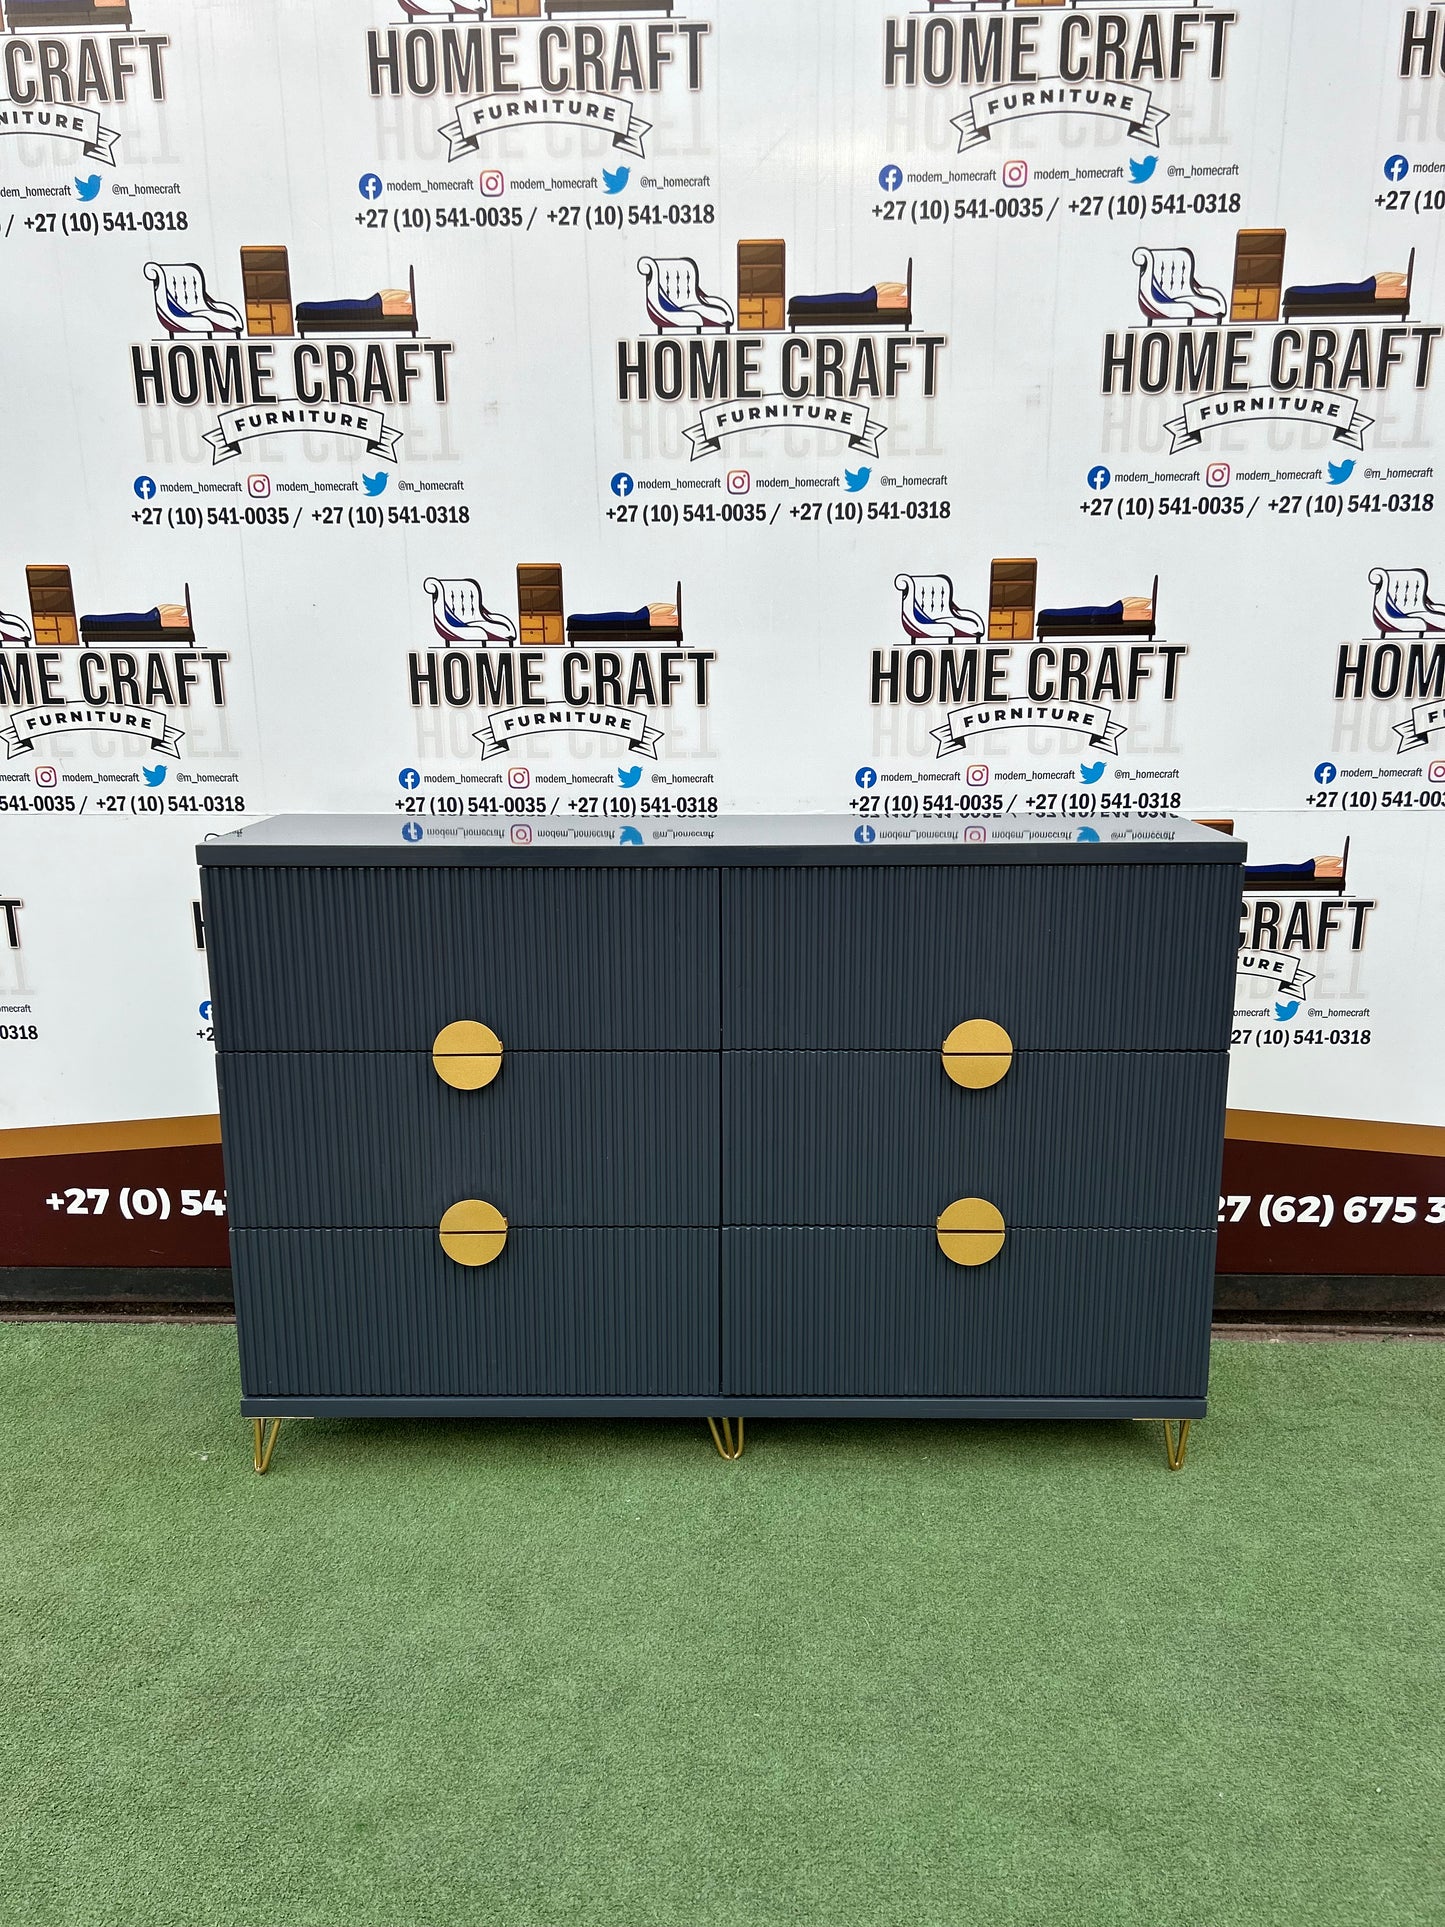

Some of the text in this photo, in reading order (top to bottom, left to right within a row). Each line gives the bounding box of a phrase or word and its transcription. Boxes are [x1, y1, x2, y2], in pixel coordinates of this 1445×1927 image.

[368, 24, 709, 96] HOME CRAFT
[886, 14, 1237, 86] HOME CRAFT
[5, 37, 170, 107] CRAFT
[474, 99, 615, 124] FURNITURE
[987, 90, 1135, 114] FURNITURE
[1168, 164, 1239, 178] @m_homecraft
[112, 183, 180, 196] @m_homecraft
[641, 176, 710, 189] @m_homecraft
[872, 201, 906, 220] +27
[912, 200, 949, 224] (10)
[954, 198, 1043, 219] 541-0035
[1069, 196, 1103, 216] +27
[1108, 195, 1146, 220] (10)
[1152, 193, 1240, 214] 541-0318
[1375, 191, 1410, 210] +27
[24, 214, 56, 232] +27
[62, 213, 98, 236] (10)
[103, 211, 188, 231] 541-0318
[355, 209, 388, 228] +27
[394, 208, 430, 232] (10)
[436, 207, 522, 227] 541-0035
[547, 207, 580, 225] +27
[586, 206, 623, 230] (10)
[629, 204, 714, 225] 541-0318
[618, 337, 946, 402] HOME CRAFT
[1103, 328, 1441, 396] HOME CRAFT
[132, 344, 453, 407] HOME CRAFT
[717, 405, 853, 426] FURNITURE
[1200, 397, 1340, 420] FURNITURE
[235, 410, 368, 431] FURNITURE
[881, 475, 947, 487] @m_homecraft
[1364, 467, 1433, 480] @m_homecraft
[398, 480, 464, 492] @m_homecraft
[606, 505, 638, 522] +27
[643, 505, 678, 526] (10)
[683, 504, 766, 522] 541-0035
[790, 503, 822, 520] +27
[827, 503, 862, 524] (10)
[868, 501, 950, 519] 541-0318
[1080, 498, 1113, 515] +27
[1118, 498, 1154, 519] (10)
[1159, 497, 1244, 515] 541-0035
[1268, 496, 1302, 513] +27
[1306, 494, 1343, 518] (10)
[1348, 494, 1434, 512] 541-0318
[132, 508, 162, 524] +27
[168, 508, 203, 529] (10)
[208, 507, 289, 525] 541-0035
[312, 507, 343, 524] +27
[349, 507, 383, 528] (10)
[388, 506, 469, 524] 541-0318
[80, 653, 229, 706] CRAFT
[409, 652, 715, 708] HOME CRAFT
[872, 646, 1187, 705] HOME CRAFT
[26, 711, 151, 729] FURNITURE
[504, 712, 631, 730] FURNITURE
[964, 708, 1094, 727] FURNITURE
[177, 773, 239, 783] @m_homecraft
[652, 774, 713, 784] @m_homecraft
[1115, 769, 1179, 780] @m_homecraft
[97, 796, 125, 811] +27
[131, 796, 164, 815] (10)
[168, 796, 245, 811] 541-0318
[395, 797, 425, 812] +27
[430, 797, 464, 815] (10)
[468, 797, 546, 812] 541-0035
[568, 797, 598, 812] +27
[603, 797, 637, 815] (10)
[641, 797, 718, 812] 541-0318
[849, 796, 880, 811] +27
[884, 796, 919, 814] (10)
[923, 795, 1003, 811] 541-0035
[1026, 794, 1057, 809] +27
[1061, 793, 1097, 813] (10)
[1101, 793, 1181, 809] 541-0318
[1306, 792, 1338, 807] +27
[1342, 792, 1377, 811] (10)
[1308, 1008, 1370, 1018] @m_homecraft
[1256, 1030, 1289, 1047] (10)
[1293, 1030, 1371, 1044] 541-0318
[45, 1187, 227, 1220] +27 (0) 54
[1259, 1194, 1335, 1227] (62)
[1343, 1196, 1417, 1224] 675
